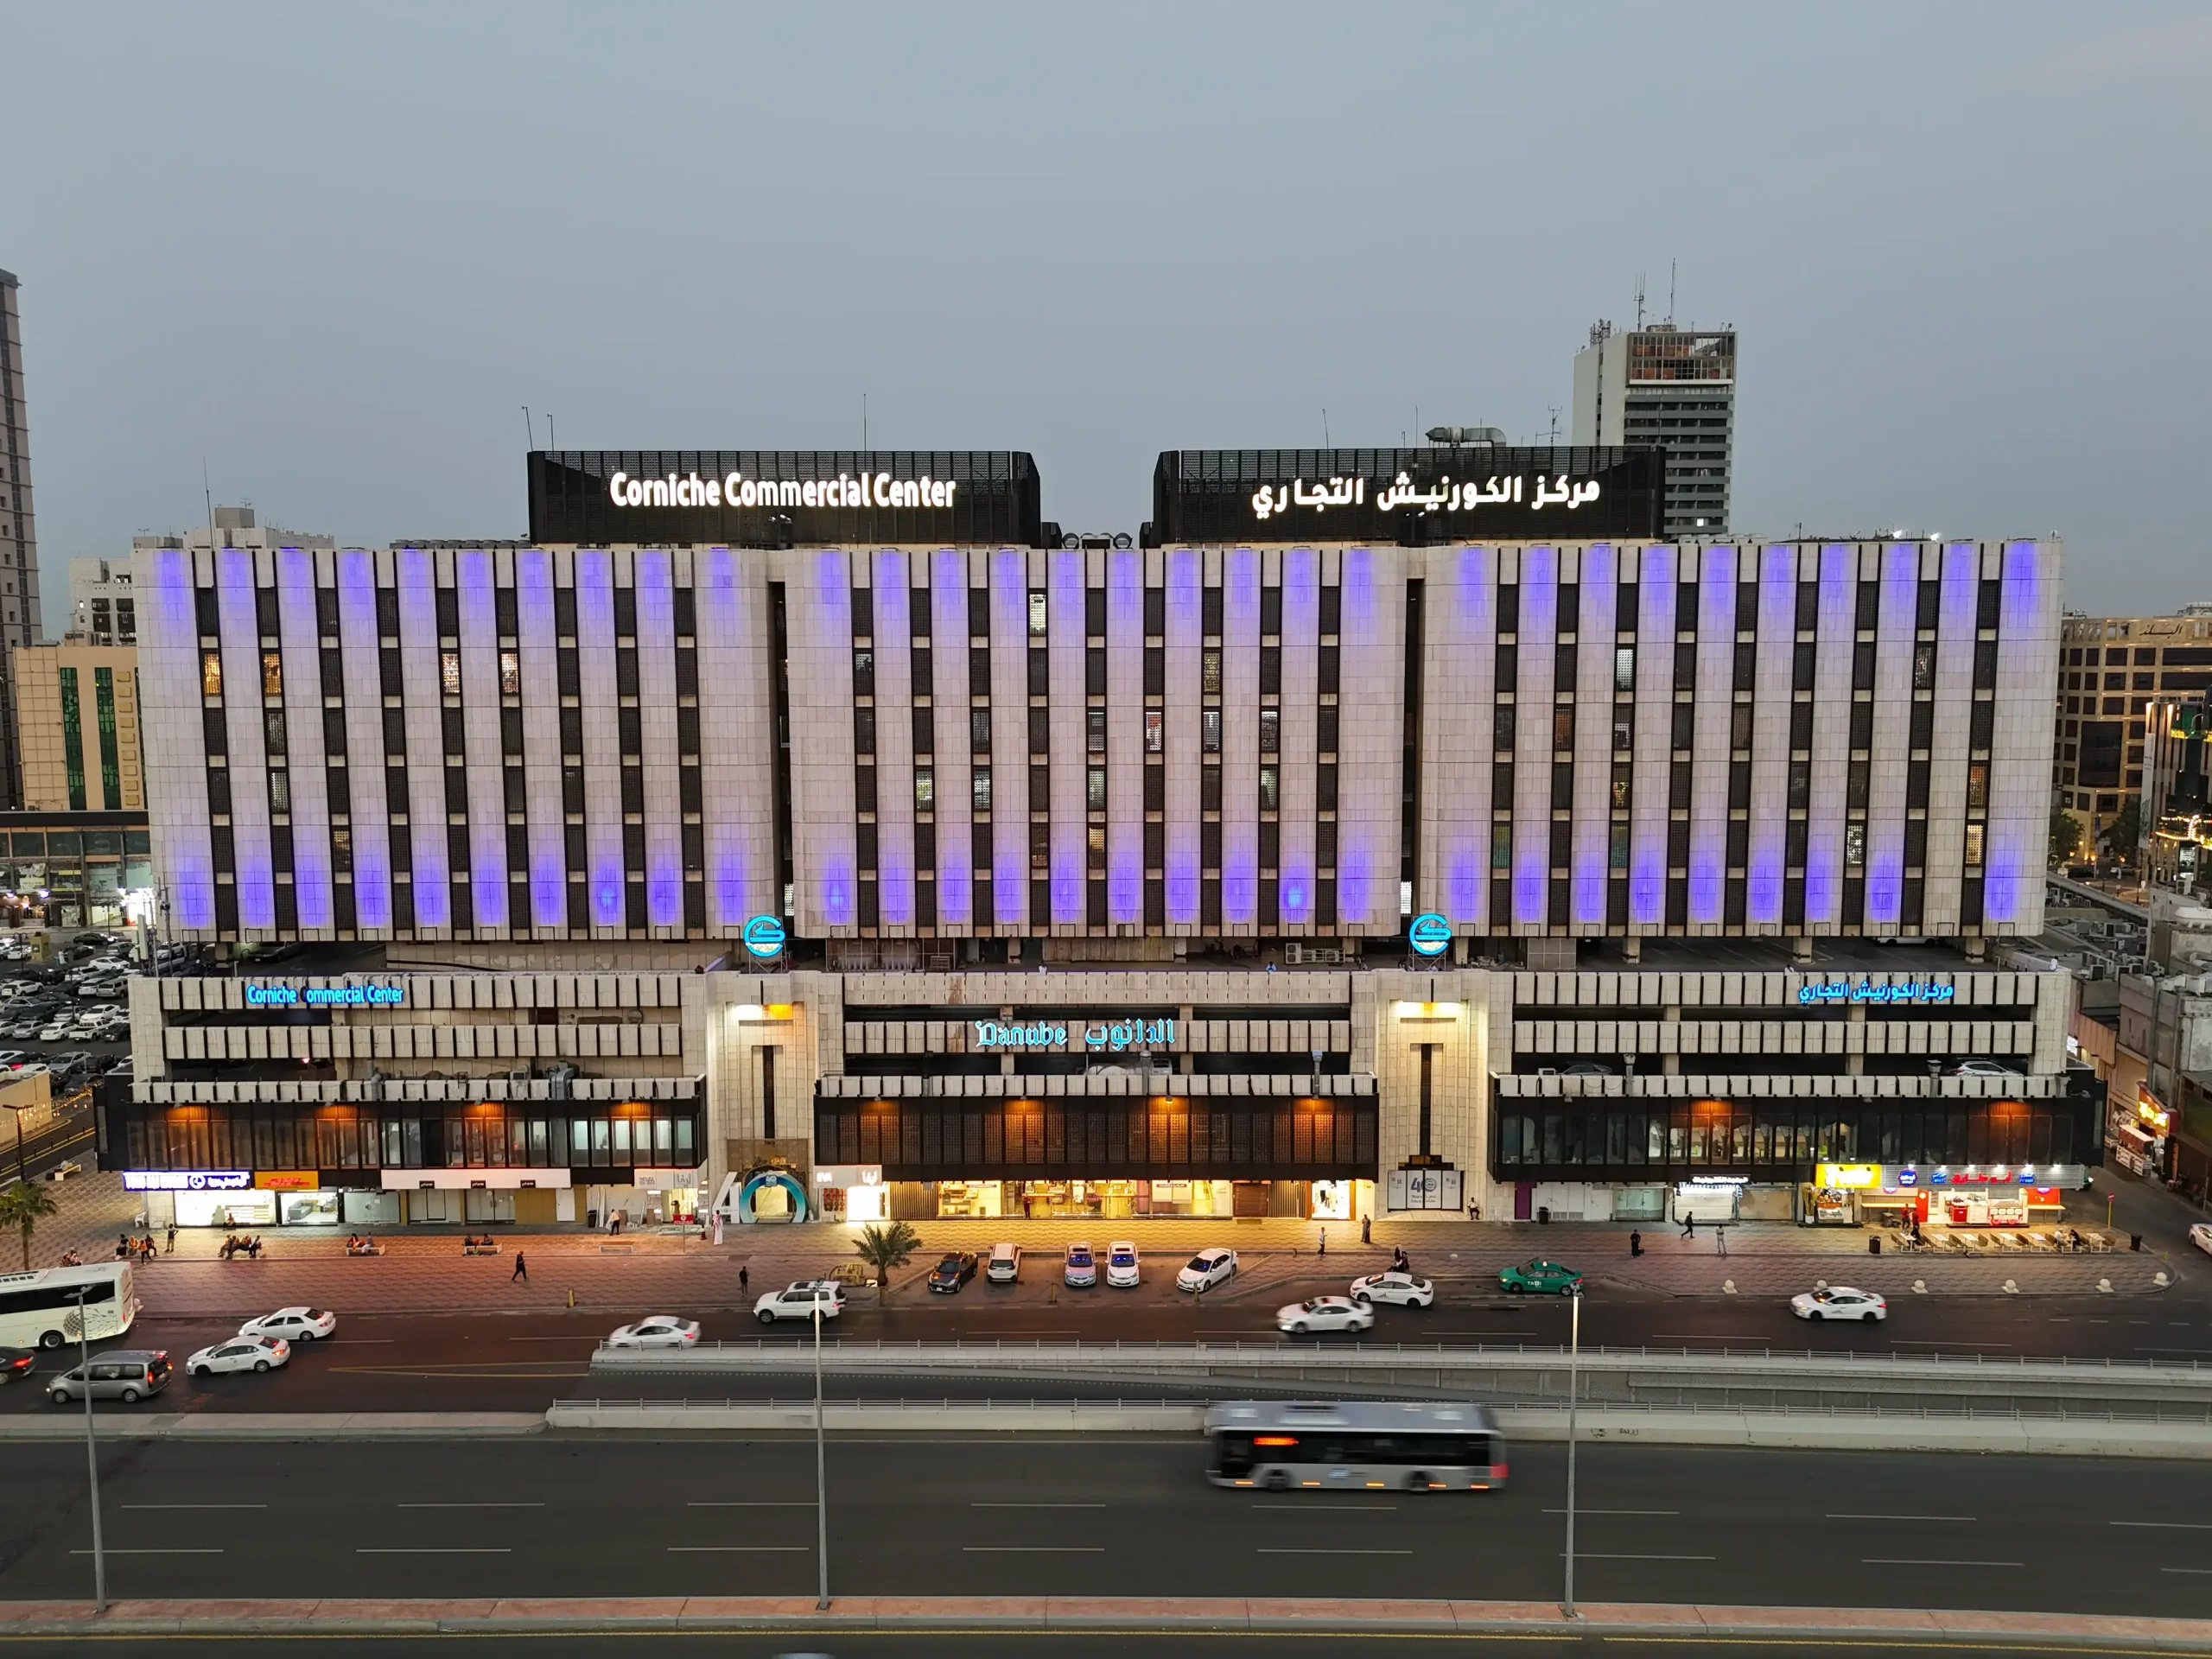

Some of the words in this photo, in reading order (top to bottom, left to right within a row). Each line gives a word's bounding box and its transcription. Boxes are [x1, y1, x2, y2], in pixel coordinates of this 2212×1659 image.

[609, 472, 721, 507] Corniche
[723, 472, 871, 507] Commercial
[873, 472, 957, 507] Center
[1251, 477, 1365, 520] التجاري
[1376, 472, 1523, 512] الكورنيش
[1531, 474, 1601, 510] مركز
[247, 984, 297, 1004] Corniche
[300, 984, 365, 1004] Commercial
[366, 984, 404, 1004] Center
[1798, 982, 1850, 1004] التجاري
[1852, 980, 1921, 1001] الكورنيش
[1922, 982, 1955, 1001] مركز
[975, 1020, 1069, 1048] Danube
[1084, 1017, 1176, 1052] الدانوب
